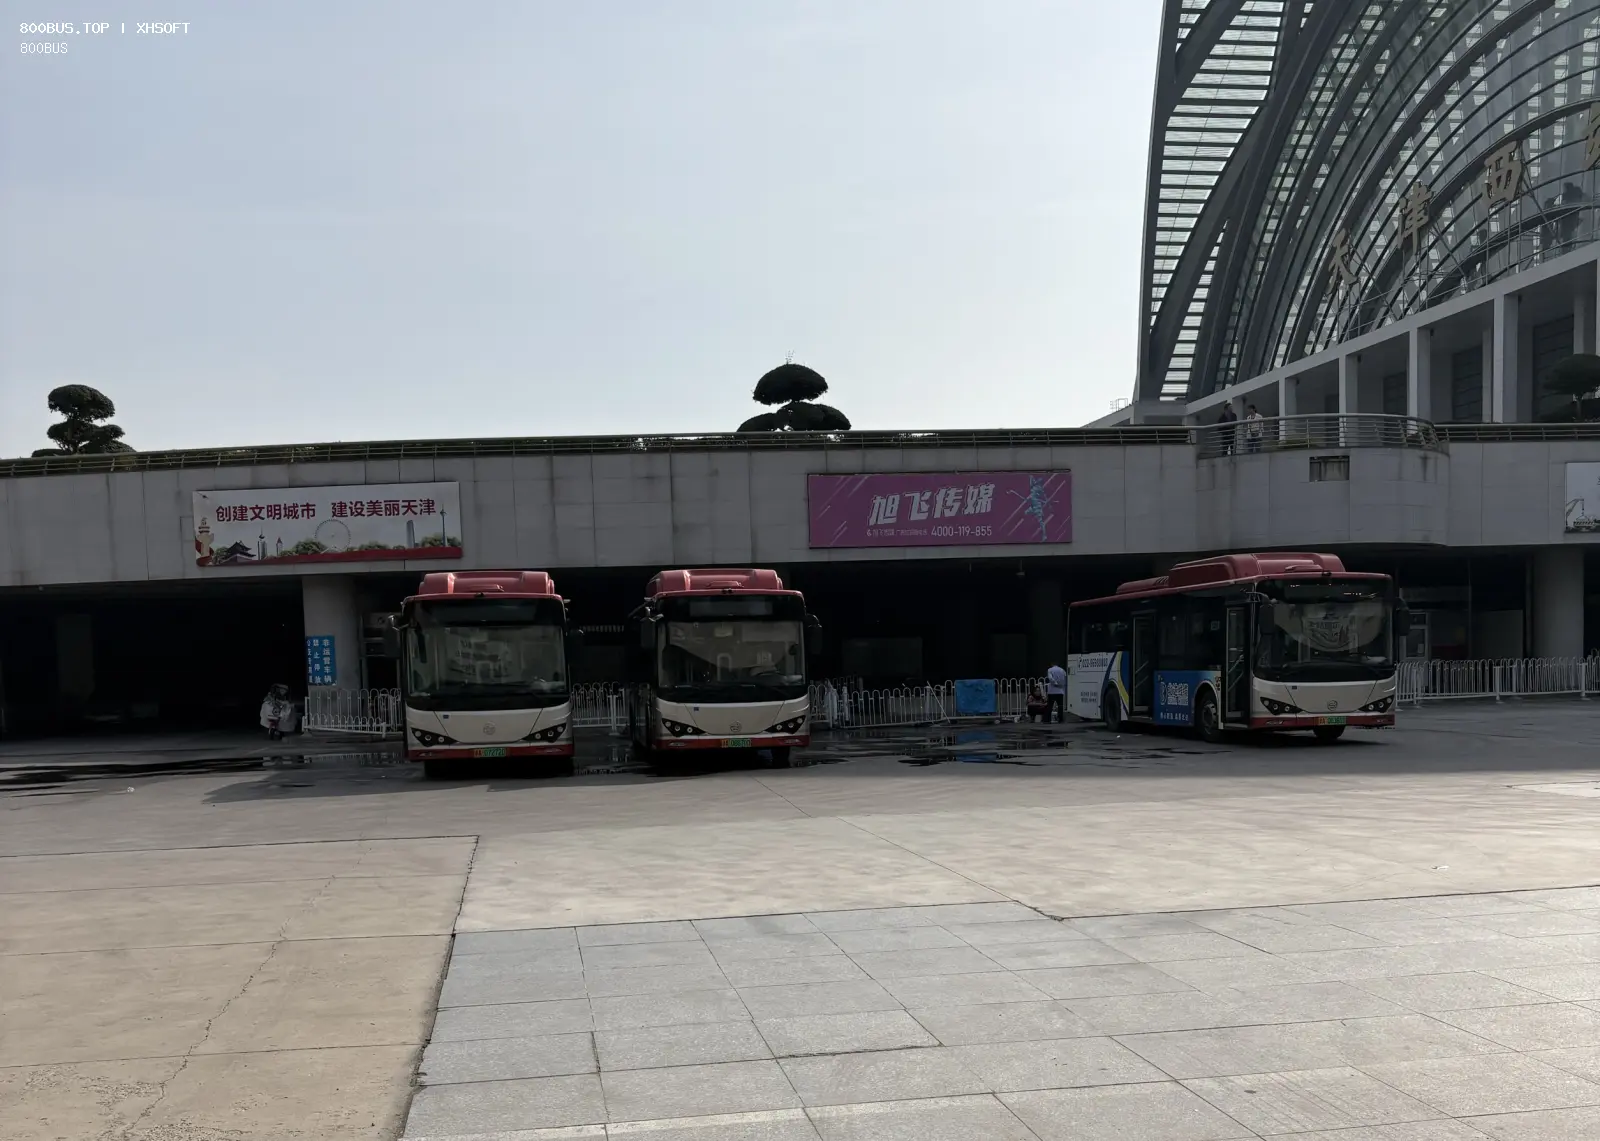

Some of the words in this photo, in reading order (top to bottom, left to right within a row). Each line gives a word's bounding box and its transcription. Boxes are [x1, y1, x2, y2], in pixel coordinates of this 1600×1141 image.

[1326, 101, 1600, 294] 天津西
[215, 502, 317, 523] 创建文明城市
[331, 498, 436, 518] 建设美丽天津
[868, 483, 996, 527] 旭飞传媒
[931, 525, 993, 538] 4000-119-855
[312, 639, 322, 684] 禁止停放
